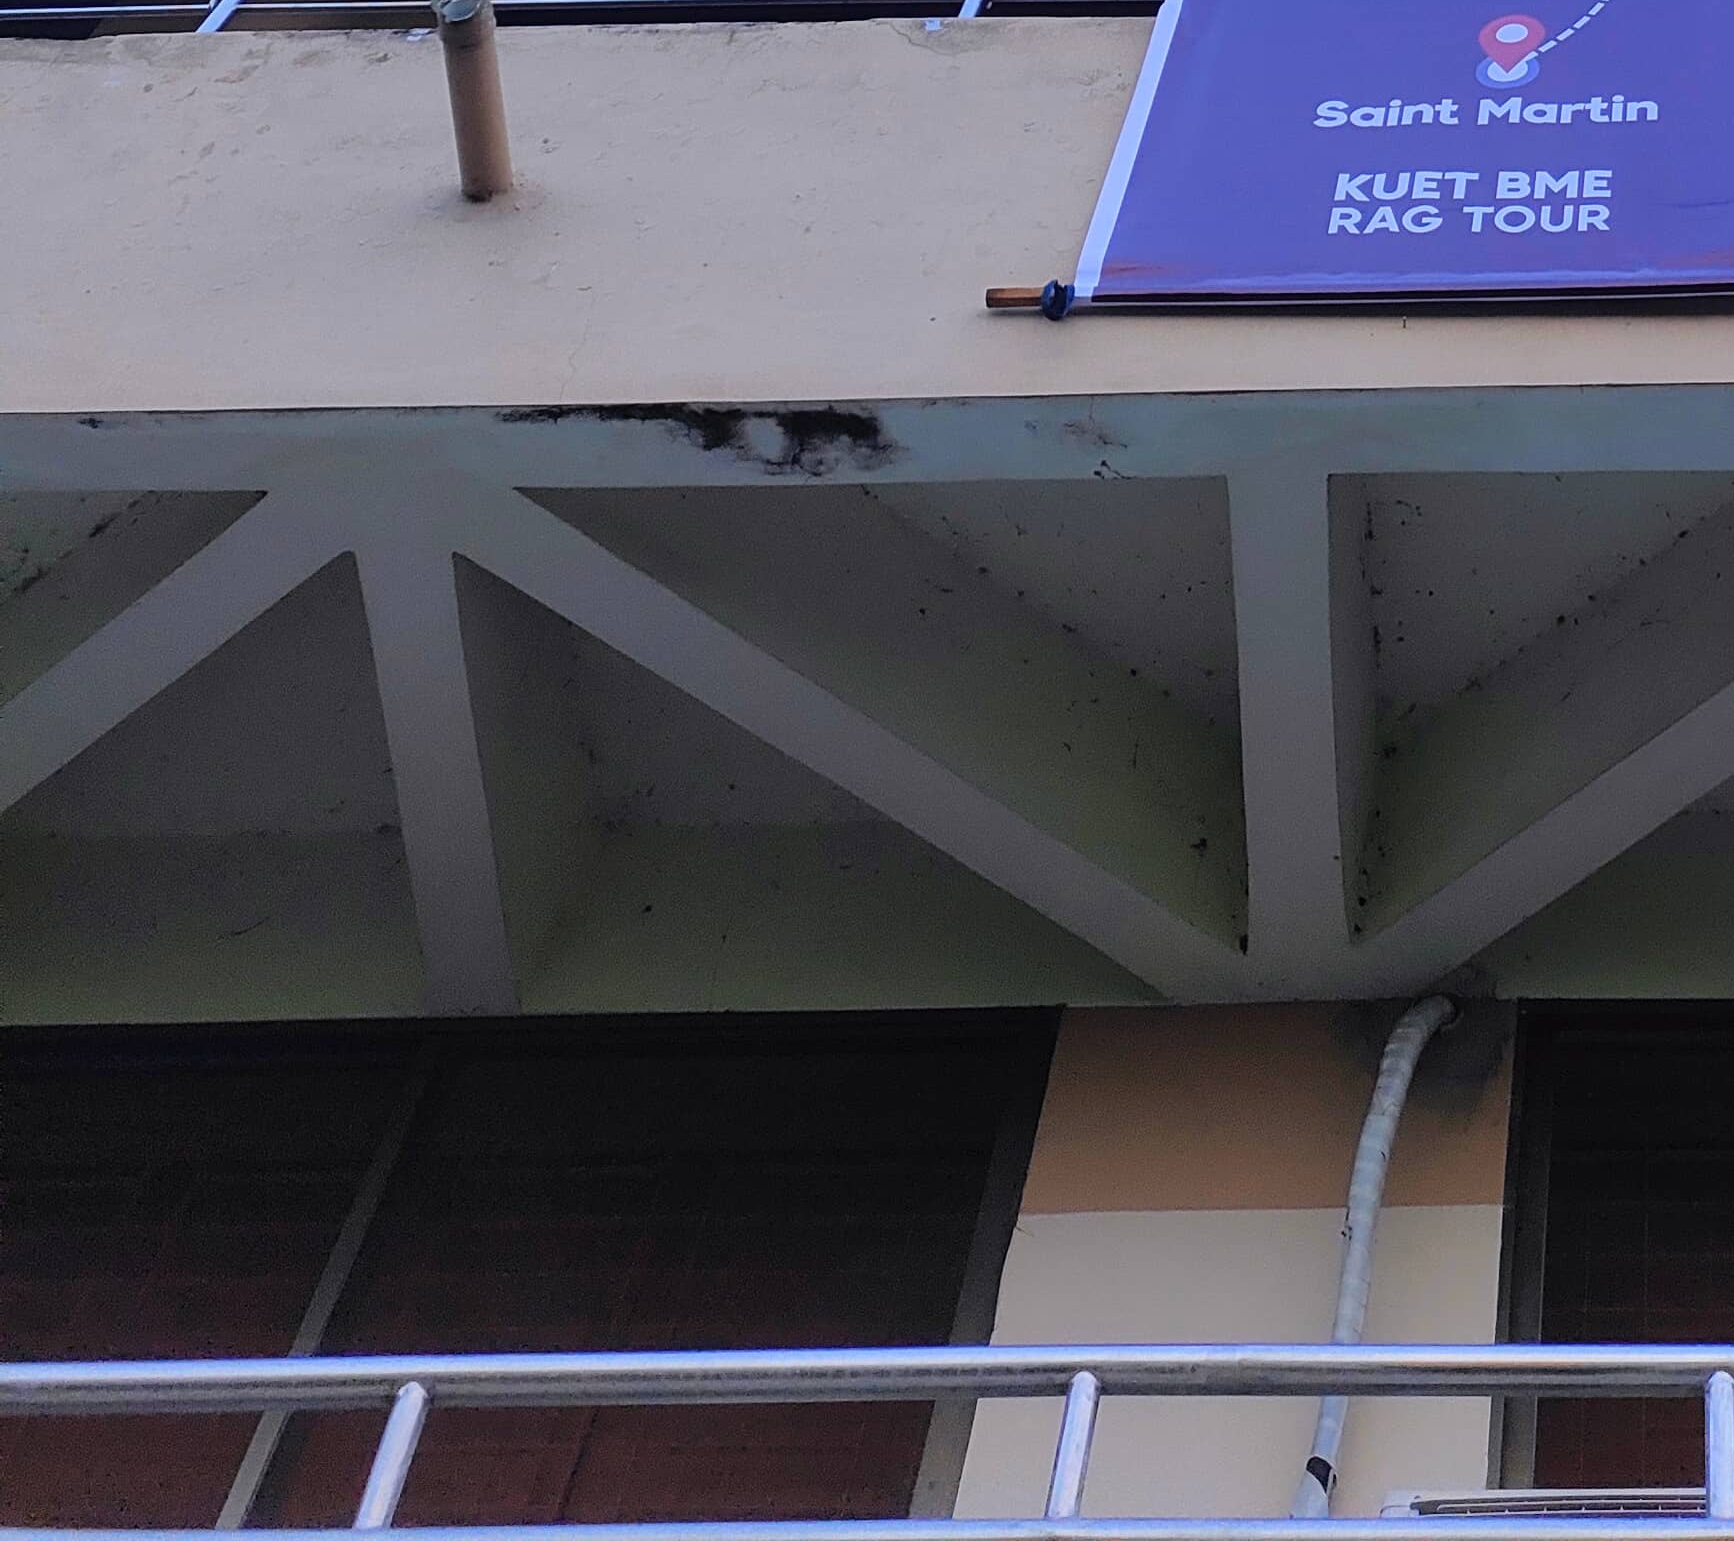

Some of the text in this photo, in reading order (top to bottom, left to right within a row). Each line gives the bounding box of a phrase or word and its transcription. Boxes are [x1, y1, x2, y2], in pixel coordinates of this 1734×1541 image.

[1312, 94, 1659, 128] Saint Martin
[1333, 169, 1613, 202] KUET BME
[1326, 204, 1610, 235] RAG TOUR
